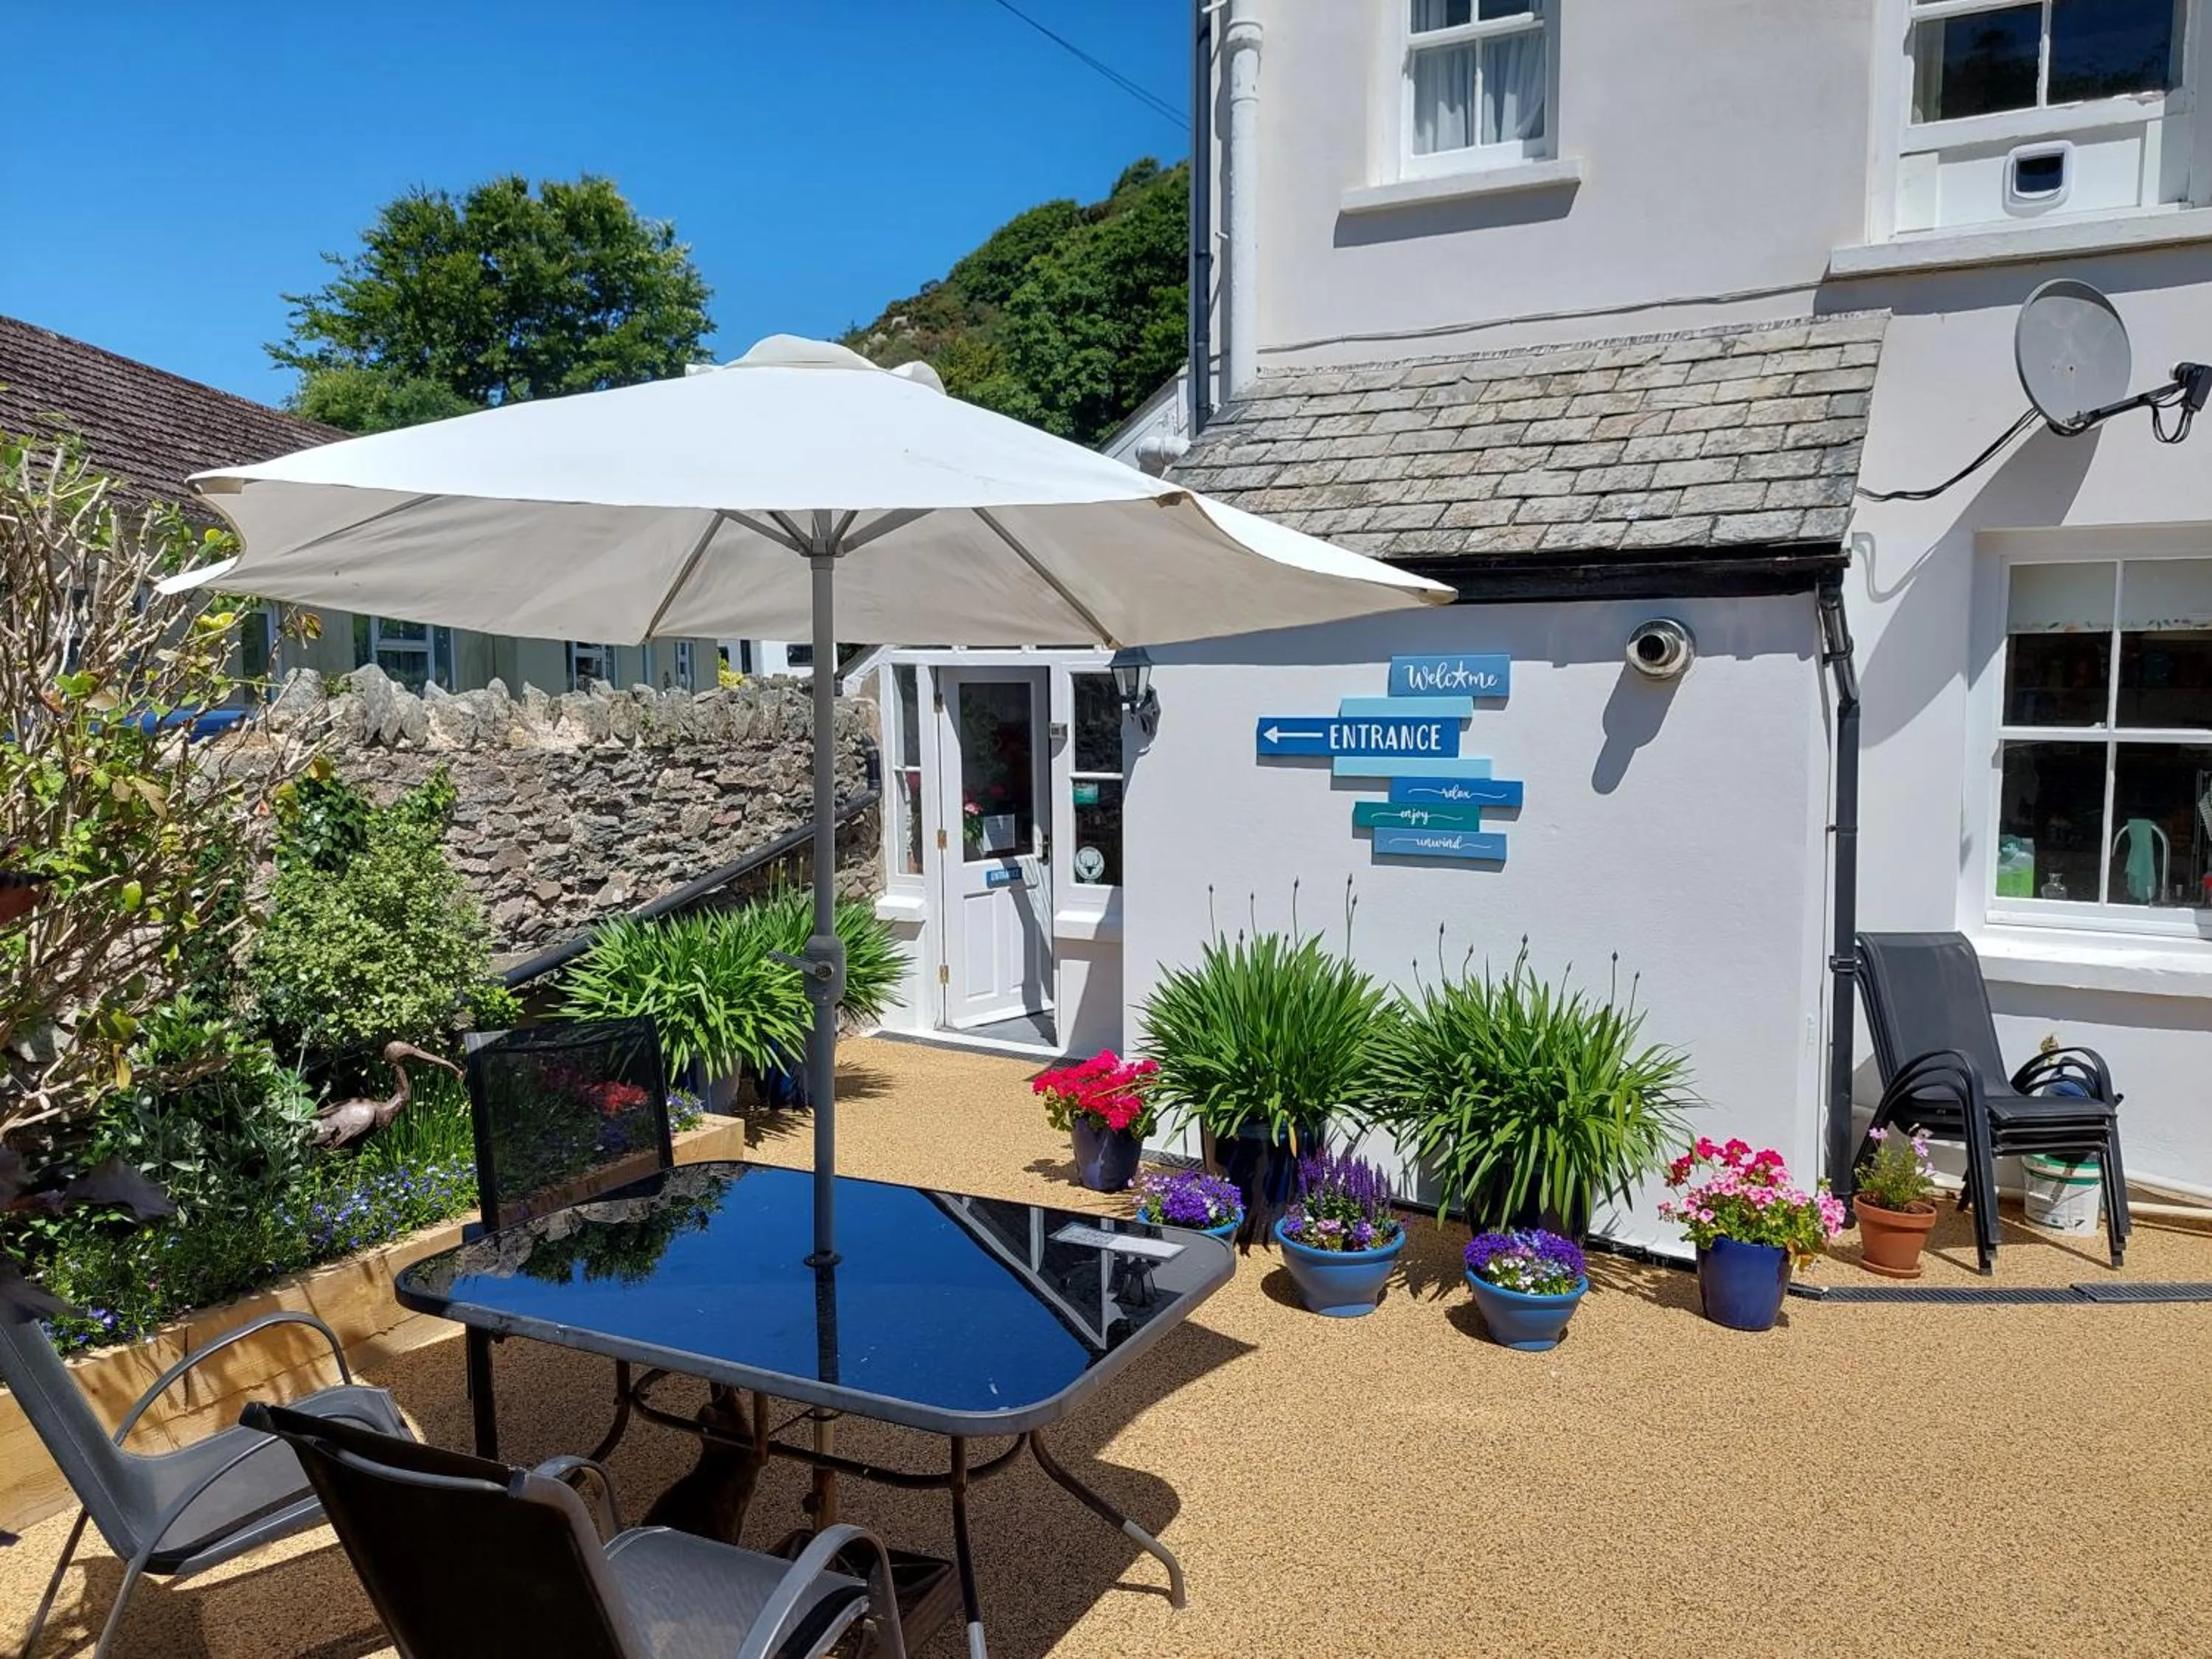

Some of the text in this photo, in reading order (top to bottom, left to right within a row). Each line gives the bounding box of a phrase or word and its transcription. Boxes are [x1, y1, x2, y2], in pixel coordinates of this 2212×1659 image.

[1329, 724, 1441, 750] ENTRANCE
[1400, 808, 1428, 825] enjoy
[1416, 835, 1463, 849] unwind
